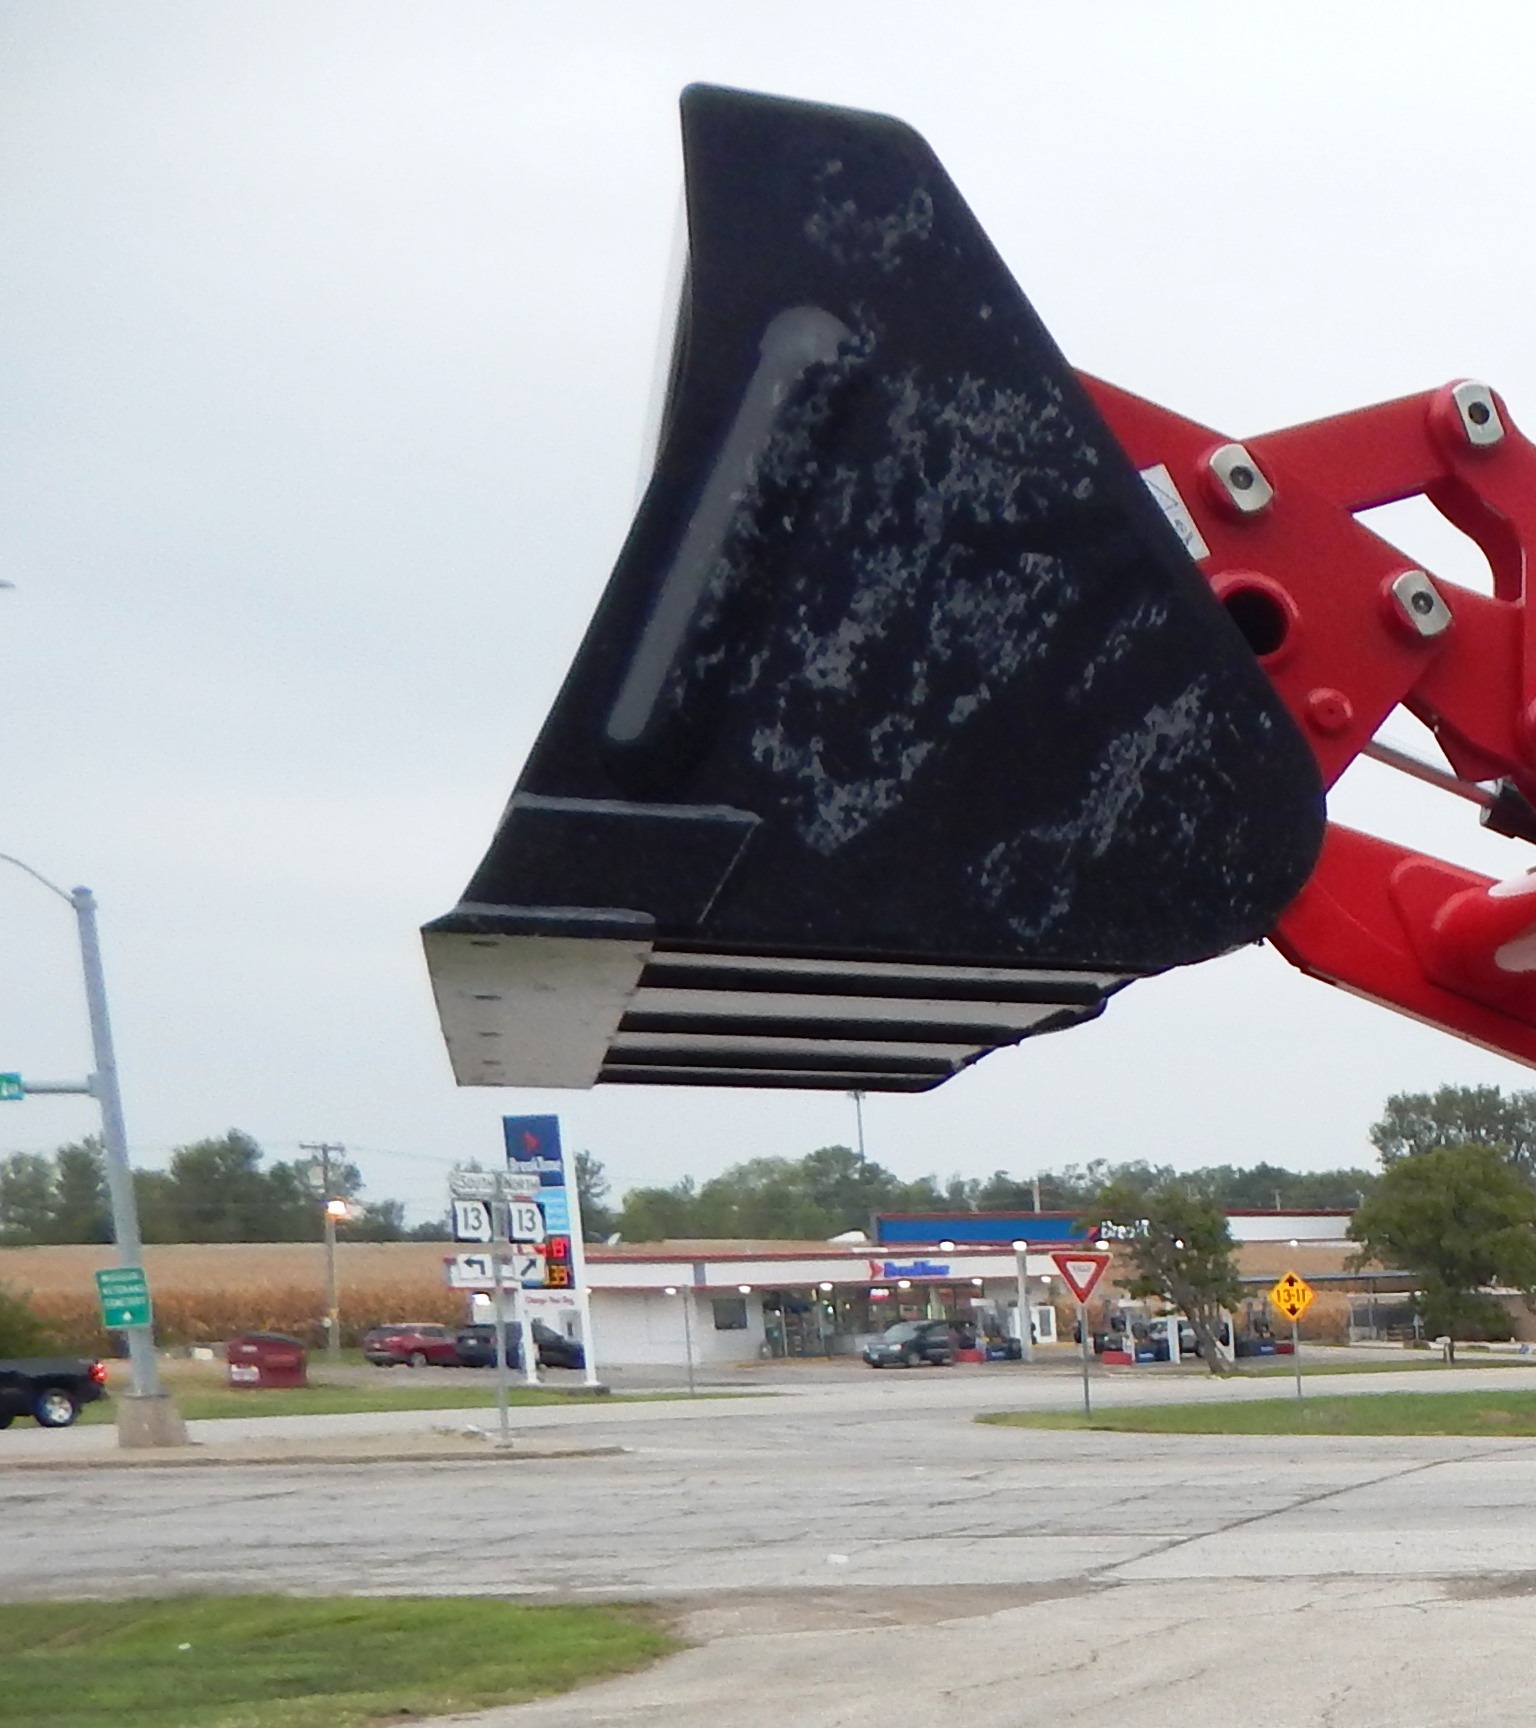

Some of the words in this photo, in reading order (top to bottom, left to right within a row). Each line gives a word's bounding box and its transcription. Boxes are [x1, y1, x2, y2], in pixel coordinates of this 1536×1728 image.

[463, 1206, 483, 1231] 13
[517, 1208, 537, 1232] 13
[1276, 1288, 1306, 1303] 13-11
